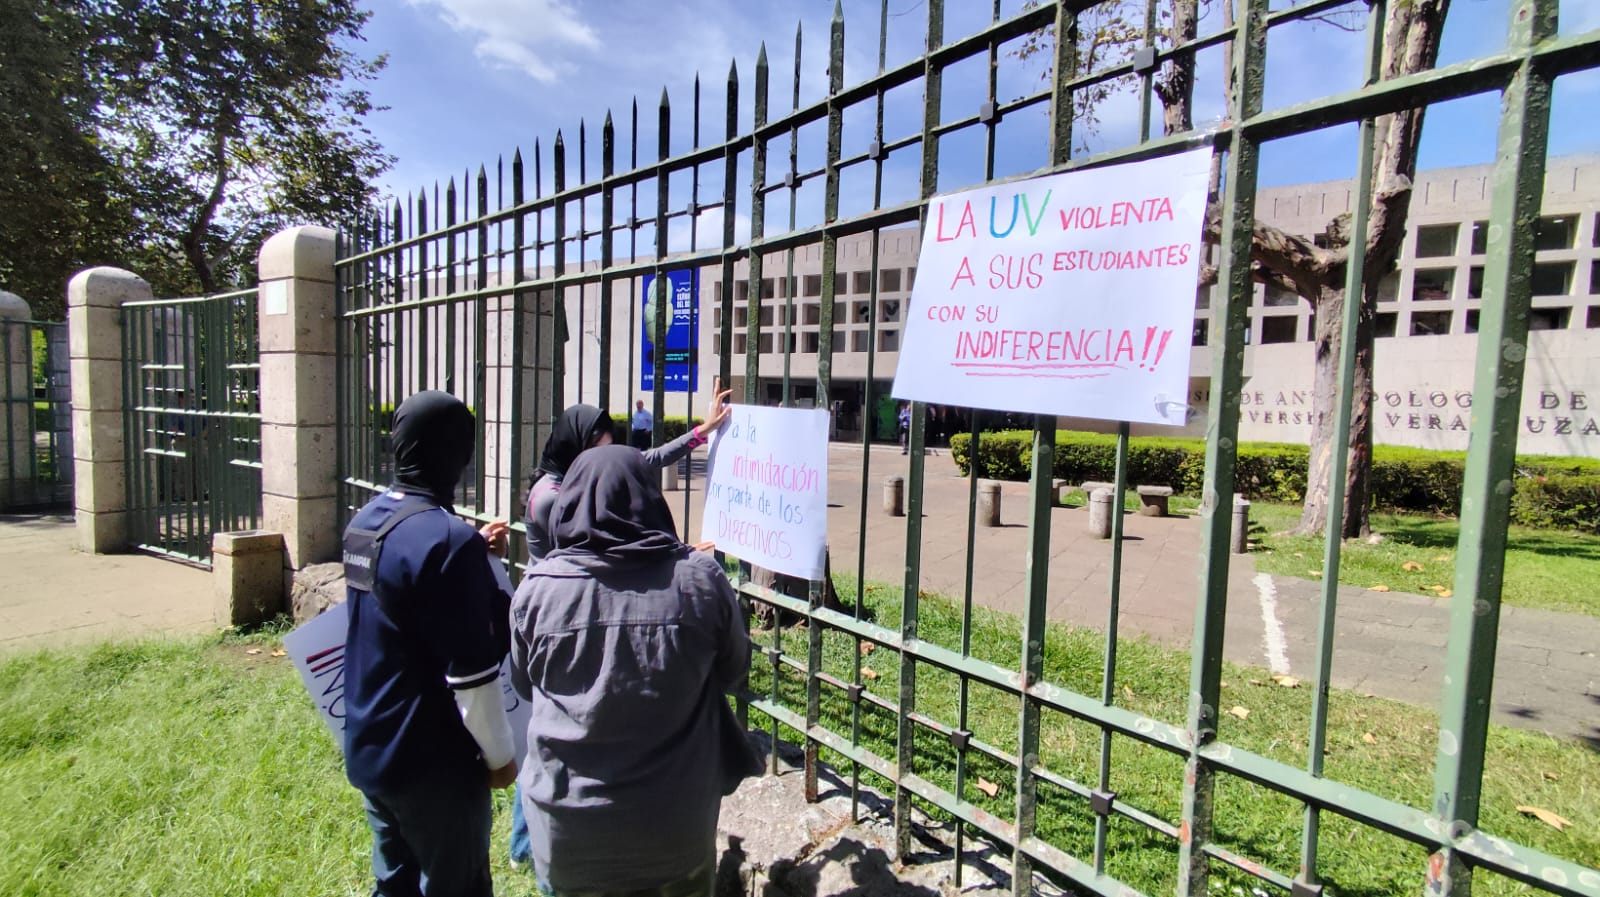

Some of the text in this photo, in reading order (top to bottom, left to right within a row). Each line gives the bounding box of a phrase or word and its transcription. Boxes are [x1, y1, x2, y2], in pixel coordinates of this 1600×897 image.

[936, 189, 1174, 242] LA UV VIOLENTA
[950, 243, 1191, 290] A SUS ESTUDIANTES
[927, 304, 999, 323] CON SU
[955, 326, 1173, 372] INDIFERENCIA!!
[1540, 391, 1588, 411] DE
[747, 413, 757, 443] la
[727, 483, 752, 513] parte
[758, 491, 772, 516] de
[778, 493, 803, 525] los
